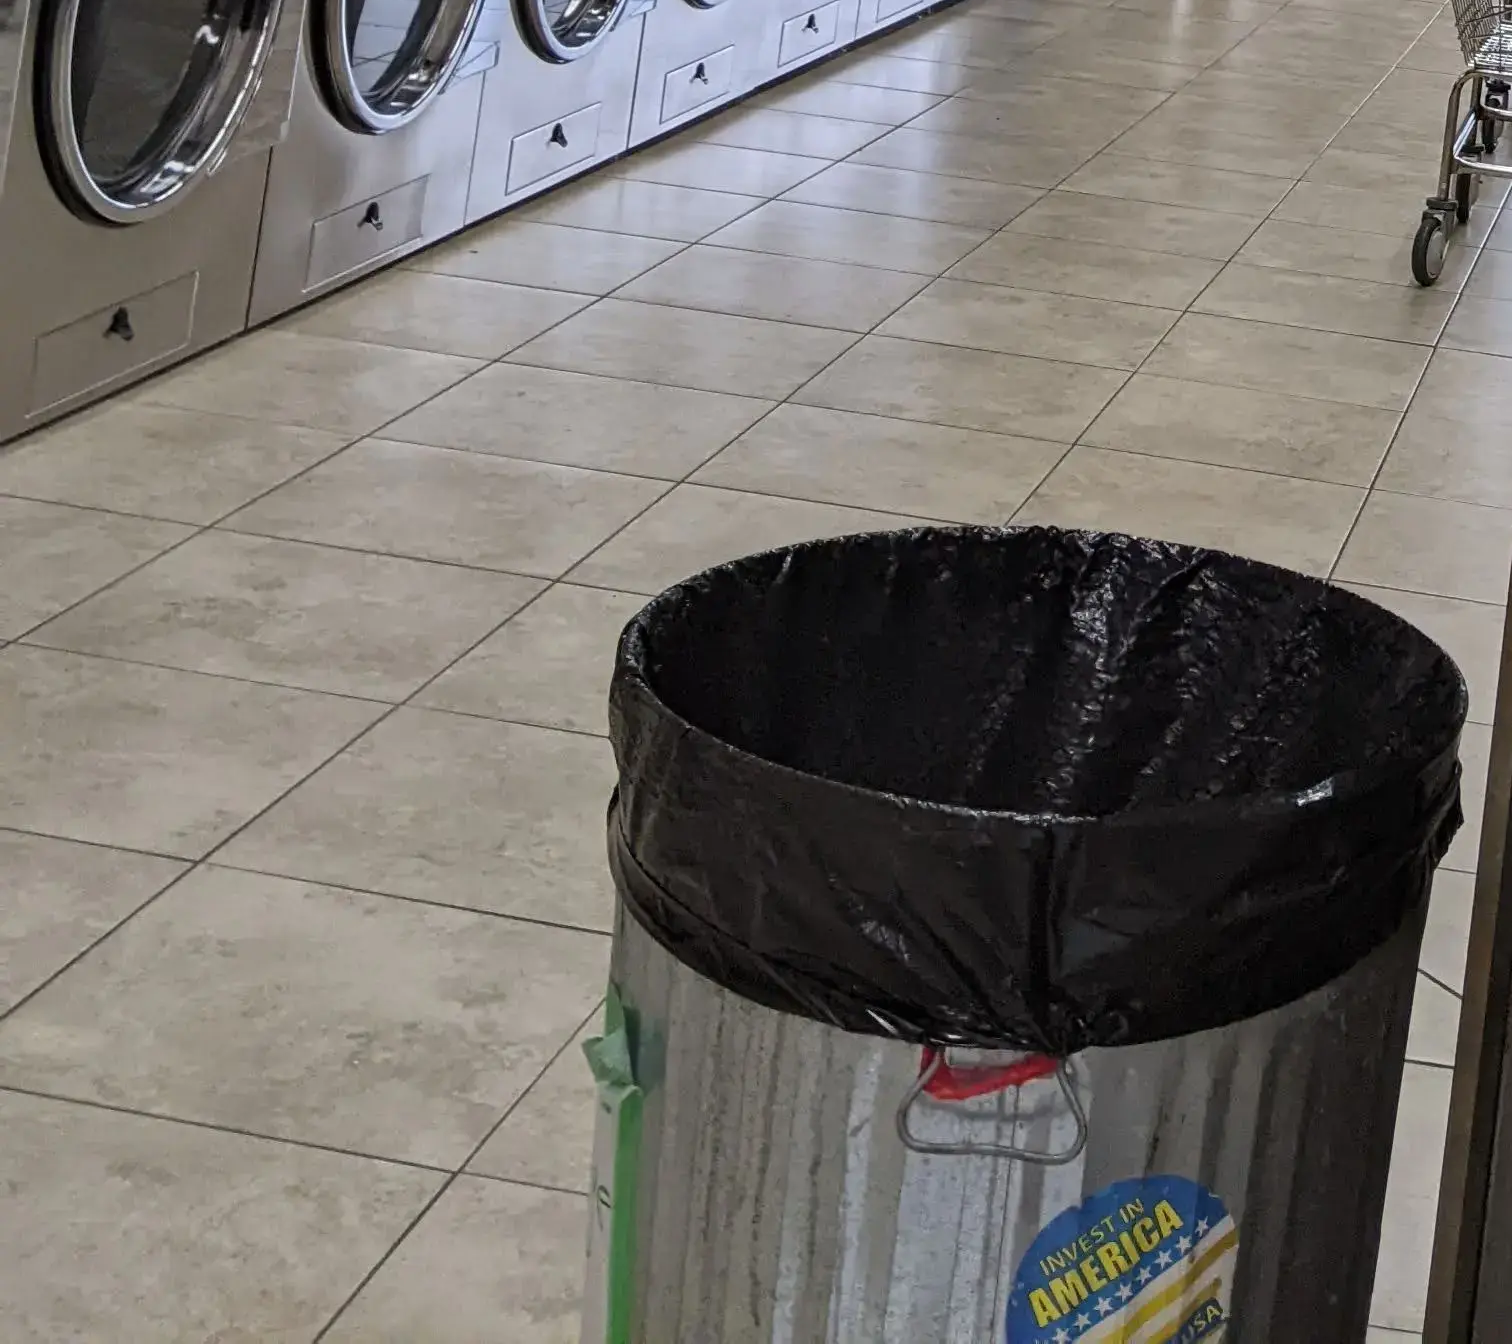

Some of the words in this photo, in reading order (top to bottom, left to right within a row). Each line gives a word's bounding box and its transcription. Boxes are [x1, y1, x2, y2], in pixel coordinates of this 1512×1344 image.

[1028, 1199, 1184, 1328] AMERICA
[1039, 1215, 1115, 1277] INVEST
[1119, 1198, 1146, 1224] IN
